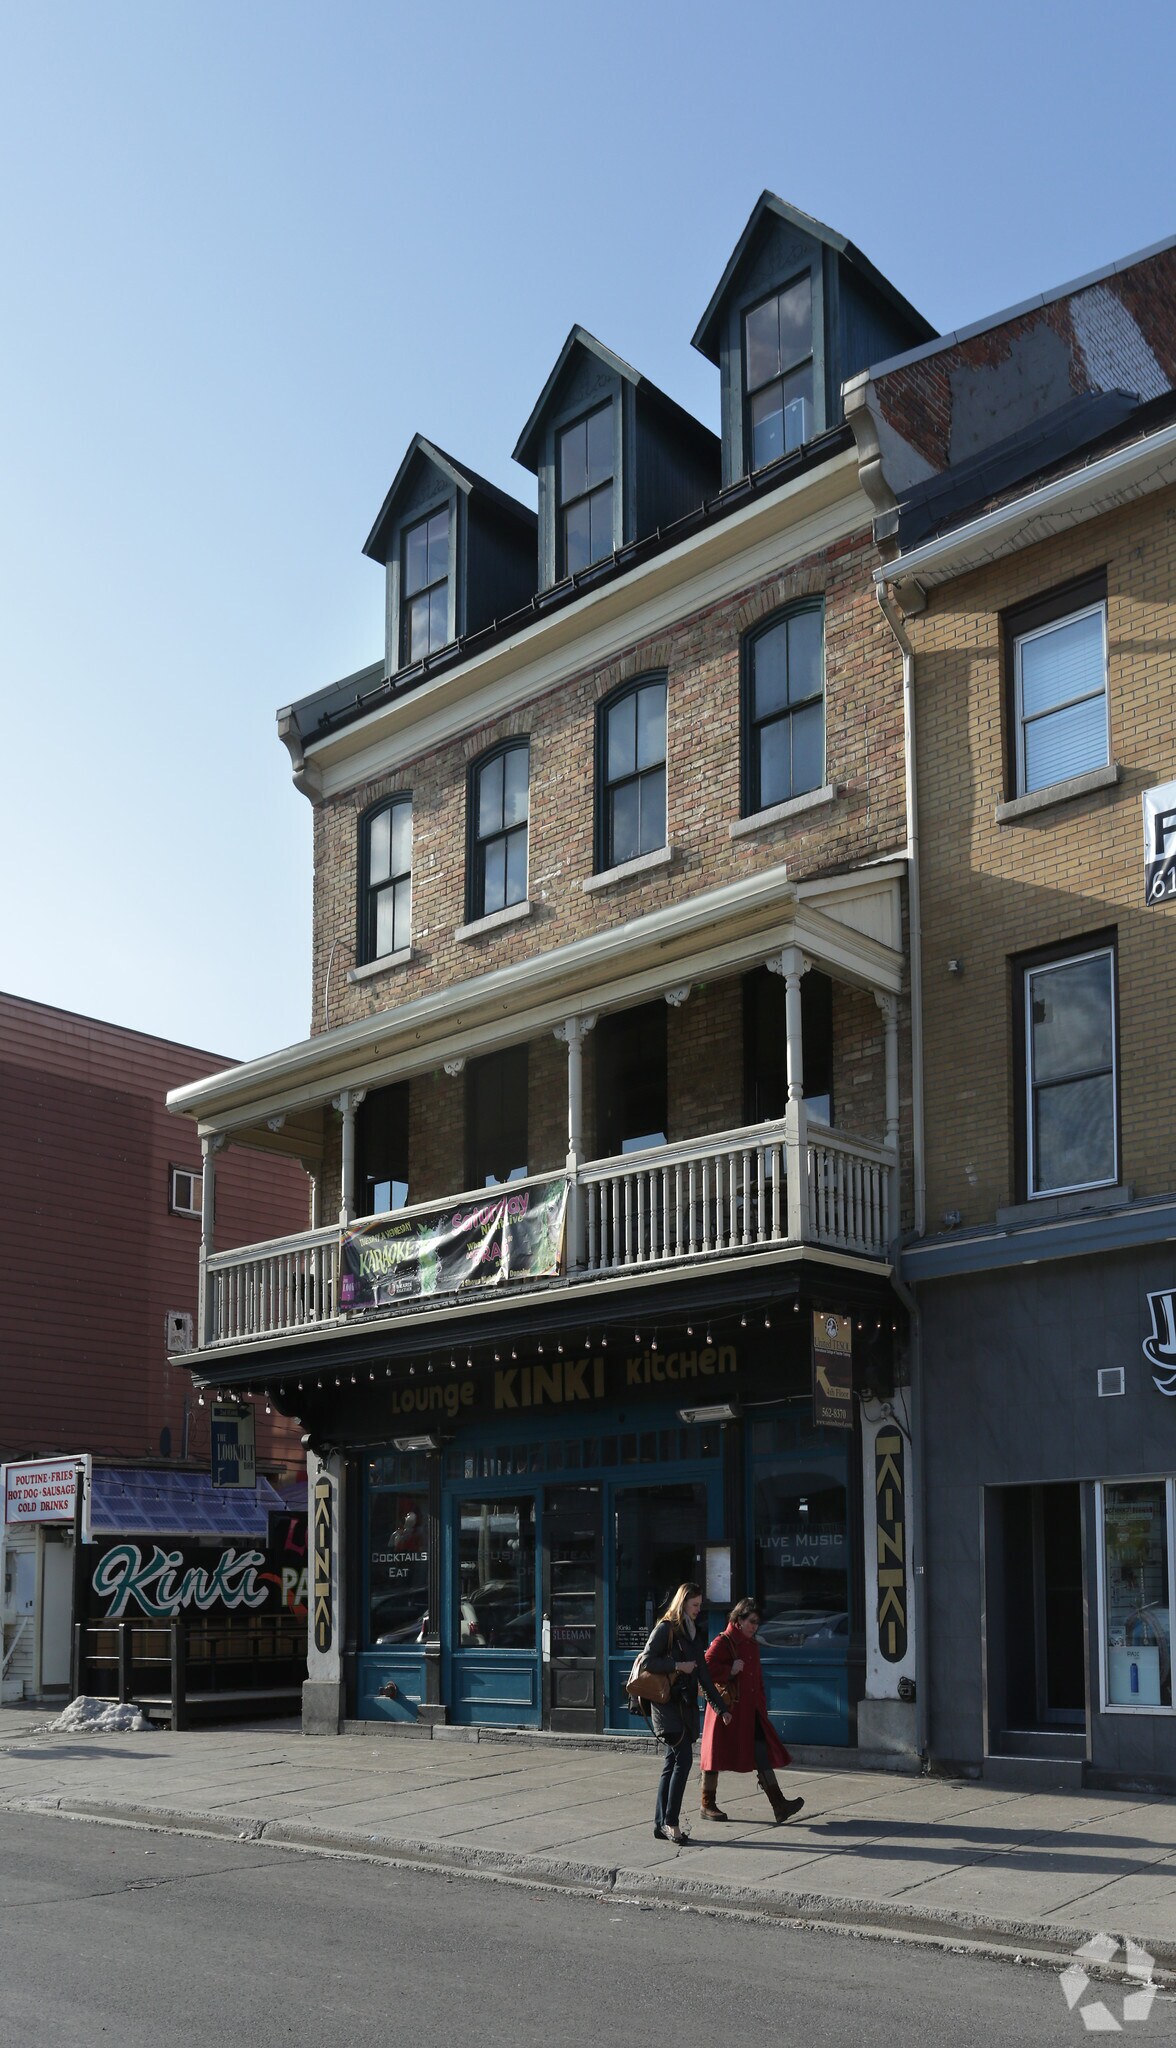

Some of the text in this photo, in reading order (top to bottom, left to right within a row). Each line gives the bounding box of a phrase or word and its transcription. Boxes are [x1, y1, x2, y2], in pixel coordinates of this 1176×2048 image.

[451, 1192, 529, 1236] Saturday
[359, 1238, 415, 1277] KARAOKE
[391, 1379, 475, 1417] Lounge
[494, 1356, 606, 1409] KINKI
[16, 1470, 73, 1486] POUTINE FRIES
[8, 1489, 22, 1500] HOT
[23, 1488, 38, 1499] DOG
[18, 1500, 69, 1513] COLD DRINKS
[759, 1534, 843, 1548] LIVE MUSIC
[876, 1435, 905, 1654] KINKI
[371, 1551, 428, 1563] COCKTAILS
[780, 1554, 820, 1567] PLAY
[315, 1484, 330, 1647] KINKI
[388, 1567, 409, 1578] EAT
[92, 1544, 270, 1617] Kinki
[552, 1629, 591, 1640] SLEEMAN
